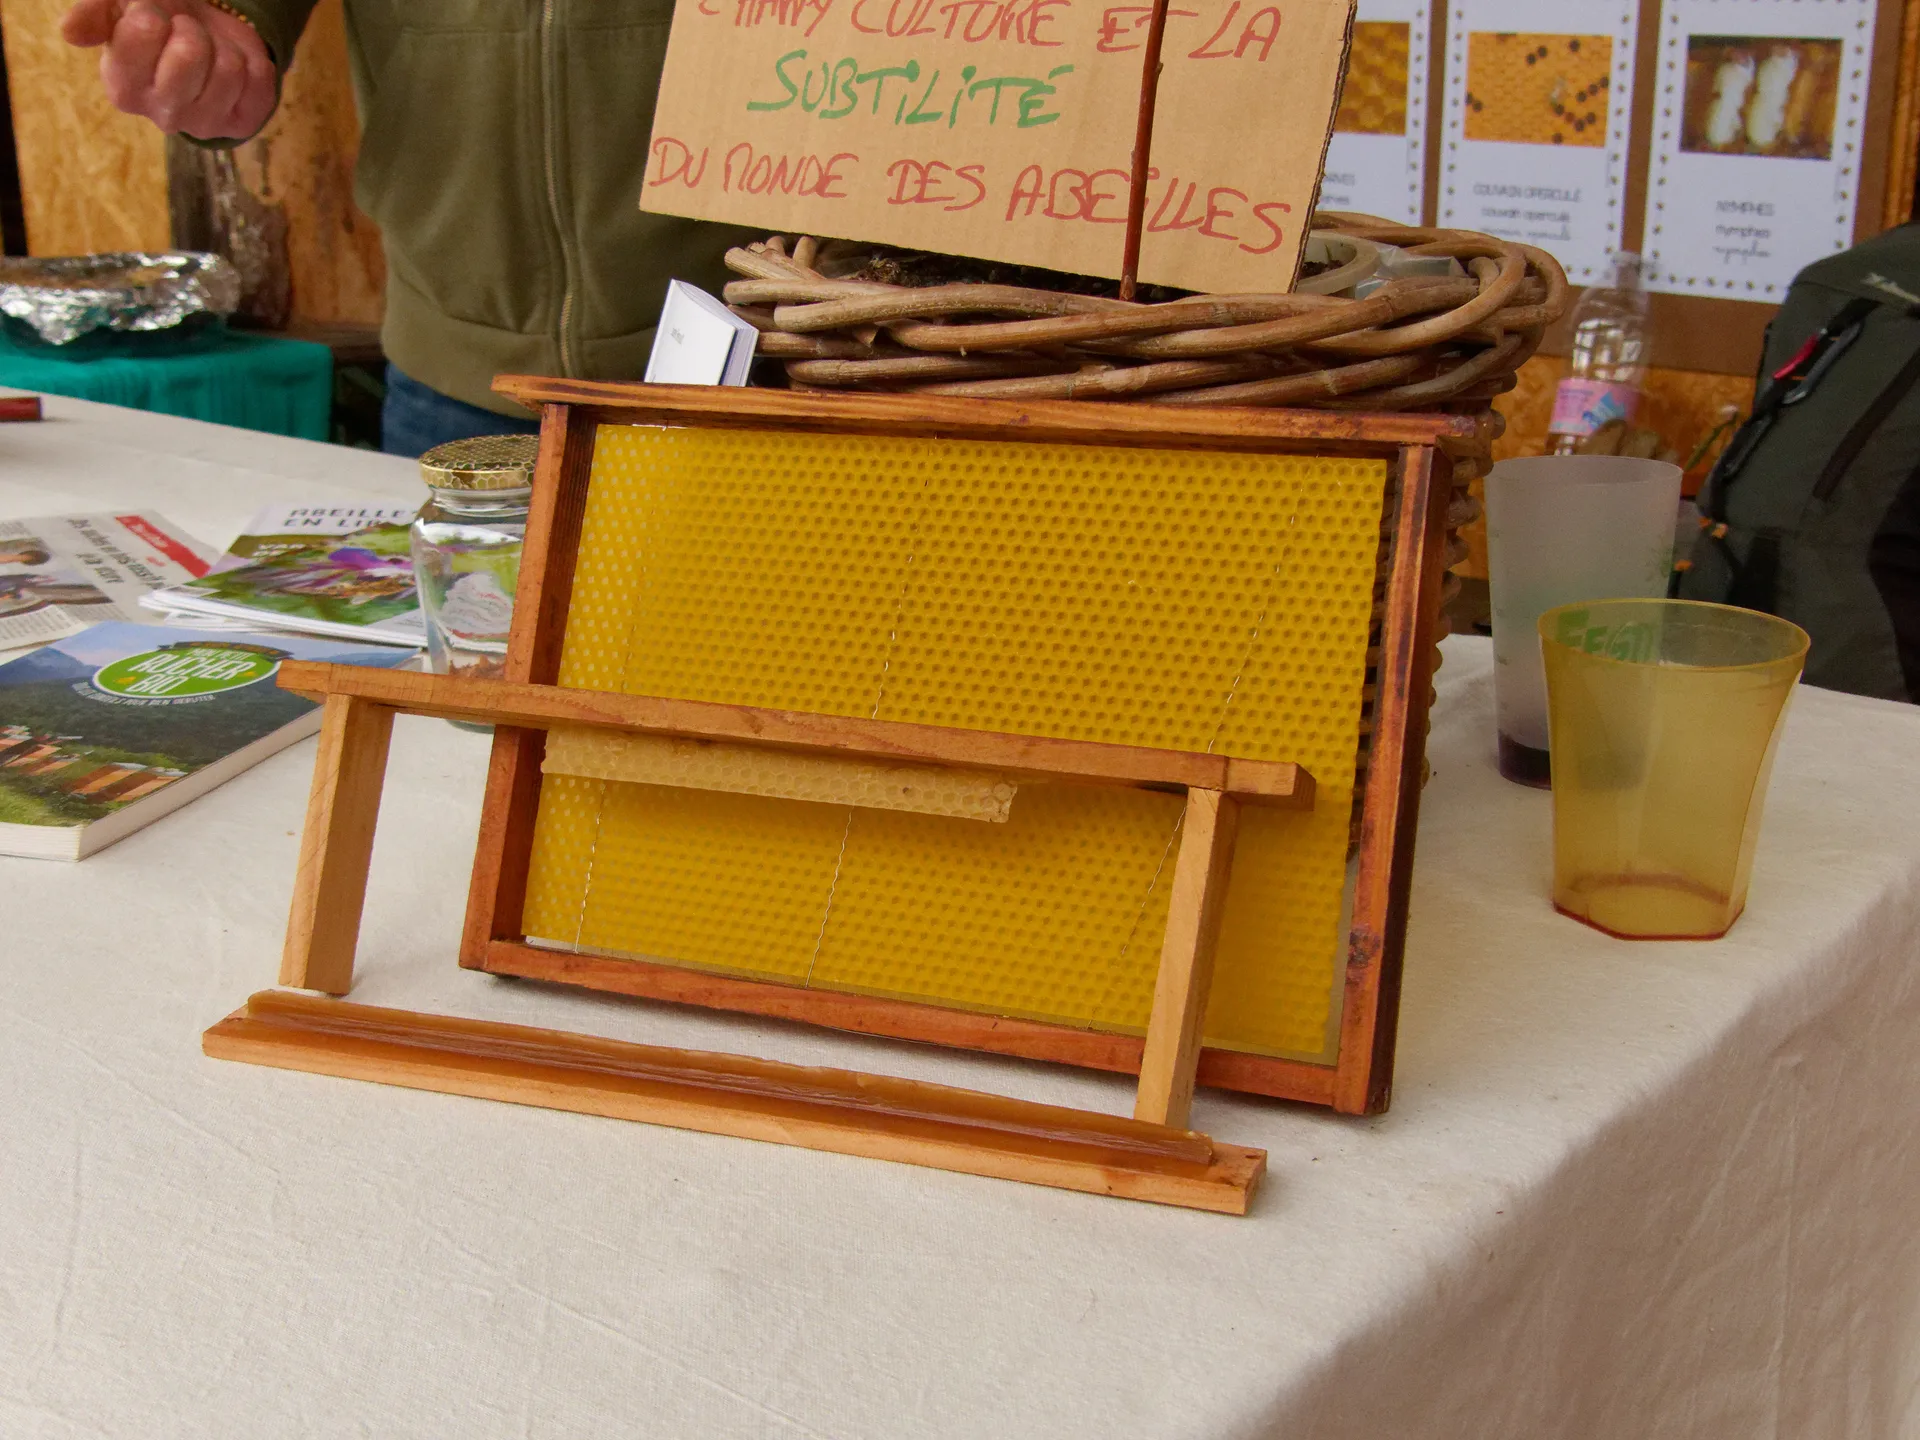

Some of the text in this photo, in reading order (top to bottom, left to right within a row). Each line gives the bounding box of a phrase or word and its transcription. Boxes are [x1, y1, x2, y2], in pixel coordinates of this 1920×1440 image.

[850, 0, 1071, 46] CULTURE
[1188, 1, 1282, 61] LA
[648, 136, 1292, 255] DU MONDE DES ABELLES
[124, 672, 190, 695] BIO
[127, 653, 257, 681] RUCHER
